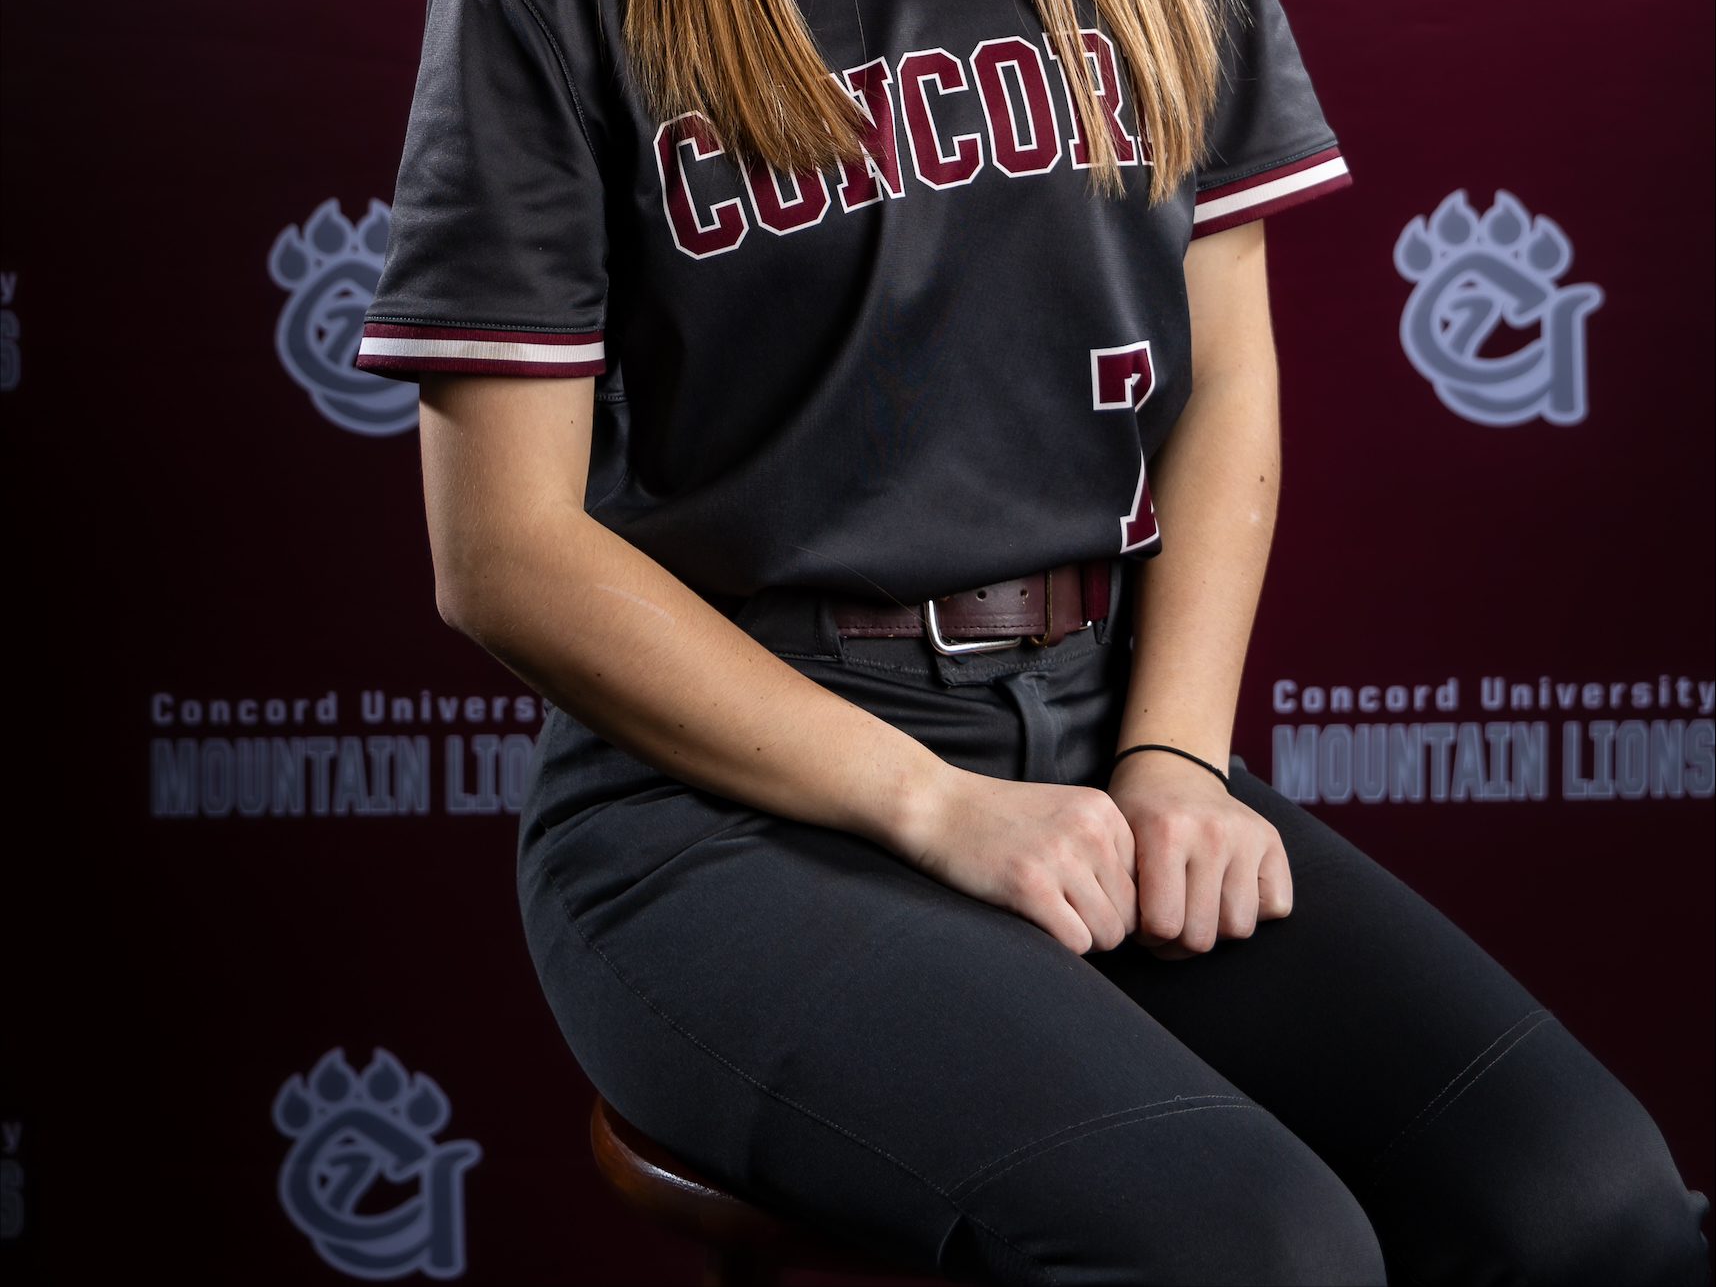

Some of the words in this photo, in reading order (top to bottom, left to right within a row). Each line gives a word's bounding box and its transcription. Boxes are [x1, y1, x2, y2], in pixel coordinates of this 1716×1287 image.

[653, 28, 1155, 259] CONCOR
[1090, 340, 1160, 554] 7
[151, 690, 338, 725] Concord
[1272, 677, 1459, 714] Concord
[1480, 675, 1714, 714] University
[152, 735, 431, 817] MOUNTAIN
[1272, 722, 1549, 804] MOUNTAIN
[1562, 719, 1714, 801] LIONS
